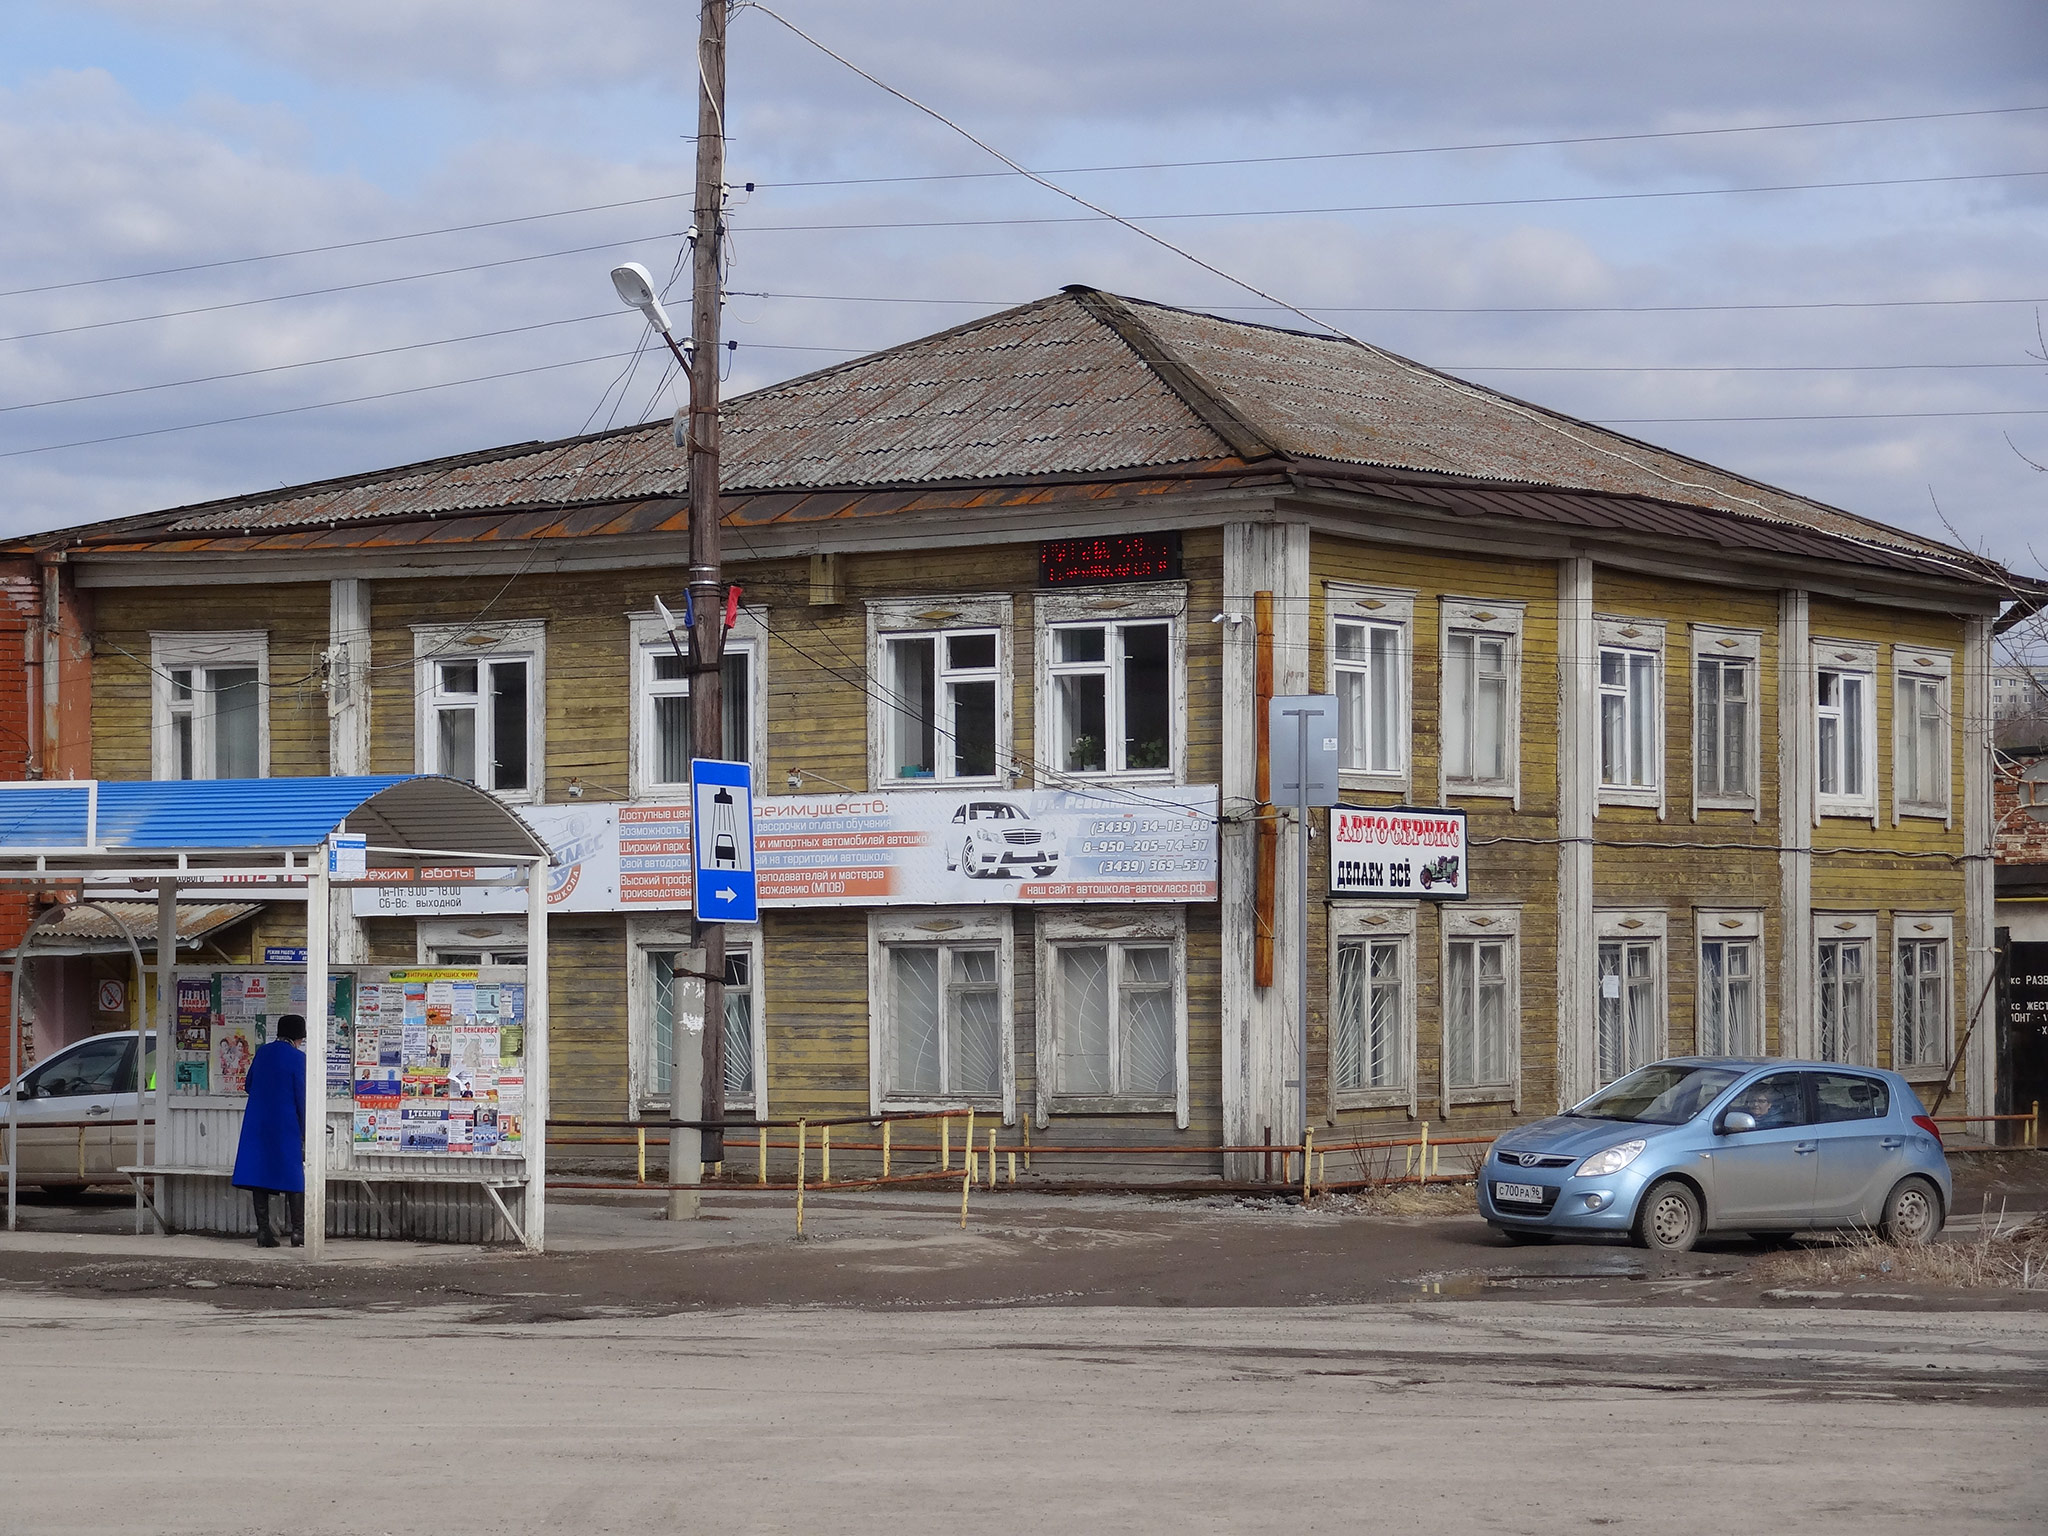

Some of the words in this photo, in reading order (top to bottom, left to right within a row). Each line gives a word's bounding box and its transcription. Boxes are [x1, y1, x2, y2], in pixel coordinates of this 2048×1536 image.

[620, 809, 670, 821] Доступные
[620, 825, 681, 837] Возможность
[757, 821, 807, 834] рассрочки
[809, 819, 844, 832] оплаты
[846, 818, 892, 831] обучения
[1090, 821, 1137, 835] (3439)
[1141, 819, 1209, 833] 34-13-88
[1337, 814, 1460, 848] АВТОСЕРВИС
[620, 841, 661, 854] Широкий
[663, 843, 686, 854] парк
[759, 840, 766, 848] и
[768, 838, 819, 849] импортных
[822, 834, 885, 847] автомобилей
[1082, 839, 1210, 853] 8-950-205-74-37
[620, 857, 642, 869] Свой
[769, 856, 780, 864] на
[783, 854, 838, 865] территории
[840, 852, 893, 863] автошколы
[1098, 860, 1145, 874] (3439)
[1149, 859, 1209, 872] 369-537
[621, 874, 660, 886] Высокий
[831, 871, 837, 879] и
[839, 870, 884, 880] мастеров
[1337, 861, 1384, 889] ДЕЛАЕМ
[1390, 858, 1411, 887] ВСЁ
[379, 886, 406, 897] Пн-Пт:
[408, 886, 427, 896] 9.00
[438, 886, 461, 896] 18.00
[760, 884, 809, 895] вождению
[811, 881, 845, 894] (МПОВ)
[1027, 885, 1046, 895] наш
[1049, 883, 1074, 895] сайт:
[1076, 882, 1206, 896] автошкола-автокласс.рф
[379, 898, 409, 909] Сб-Вс:
[416, 898, 461, 908] выходной
[409, 1110, 442, 1119] LTECHNO
[1500, 1184, 1530, 1198] С700РА
[1531, 1186, 1540, 1196] 96
